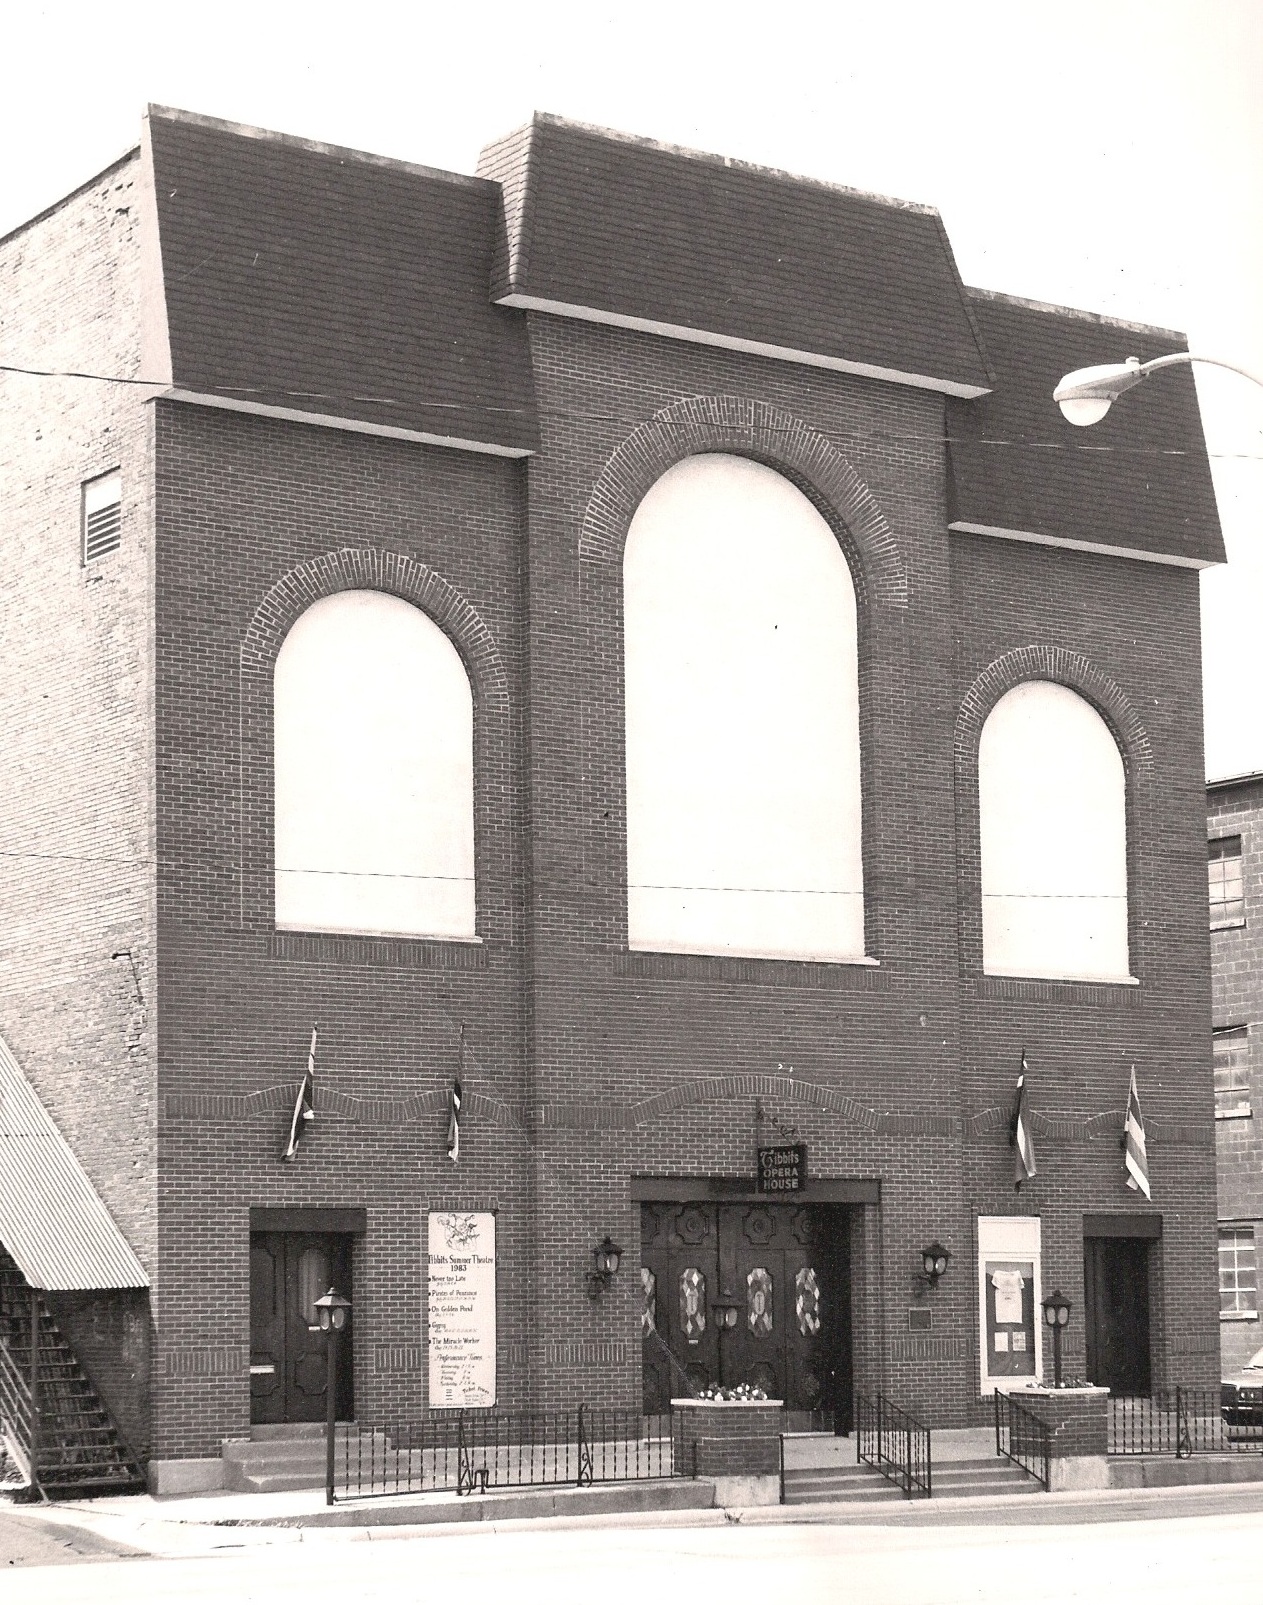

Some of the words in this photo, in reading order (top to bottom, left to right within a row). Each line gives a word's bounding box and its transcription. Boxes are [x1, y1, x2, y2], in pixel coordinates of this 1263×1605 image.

[760, 1150, 799, 1168] Tibbits
[763, 1168, 798, 1177] OPERA
[763, 1179, 798, 1189] HOUSE
[449, 1254, 471, 1264] Summer
[471, 1254, 494, 1264] Theatre
[459, 1304, 473, 1312] Pond
